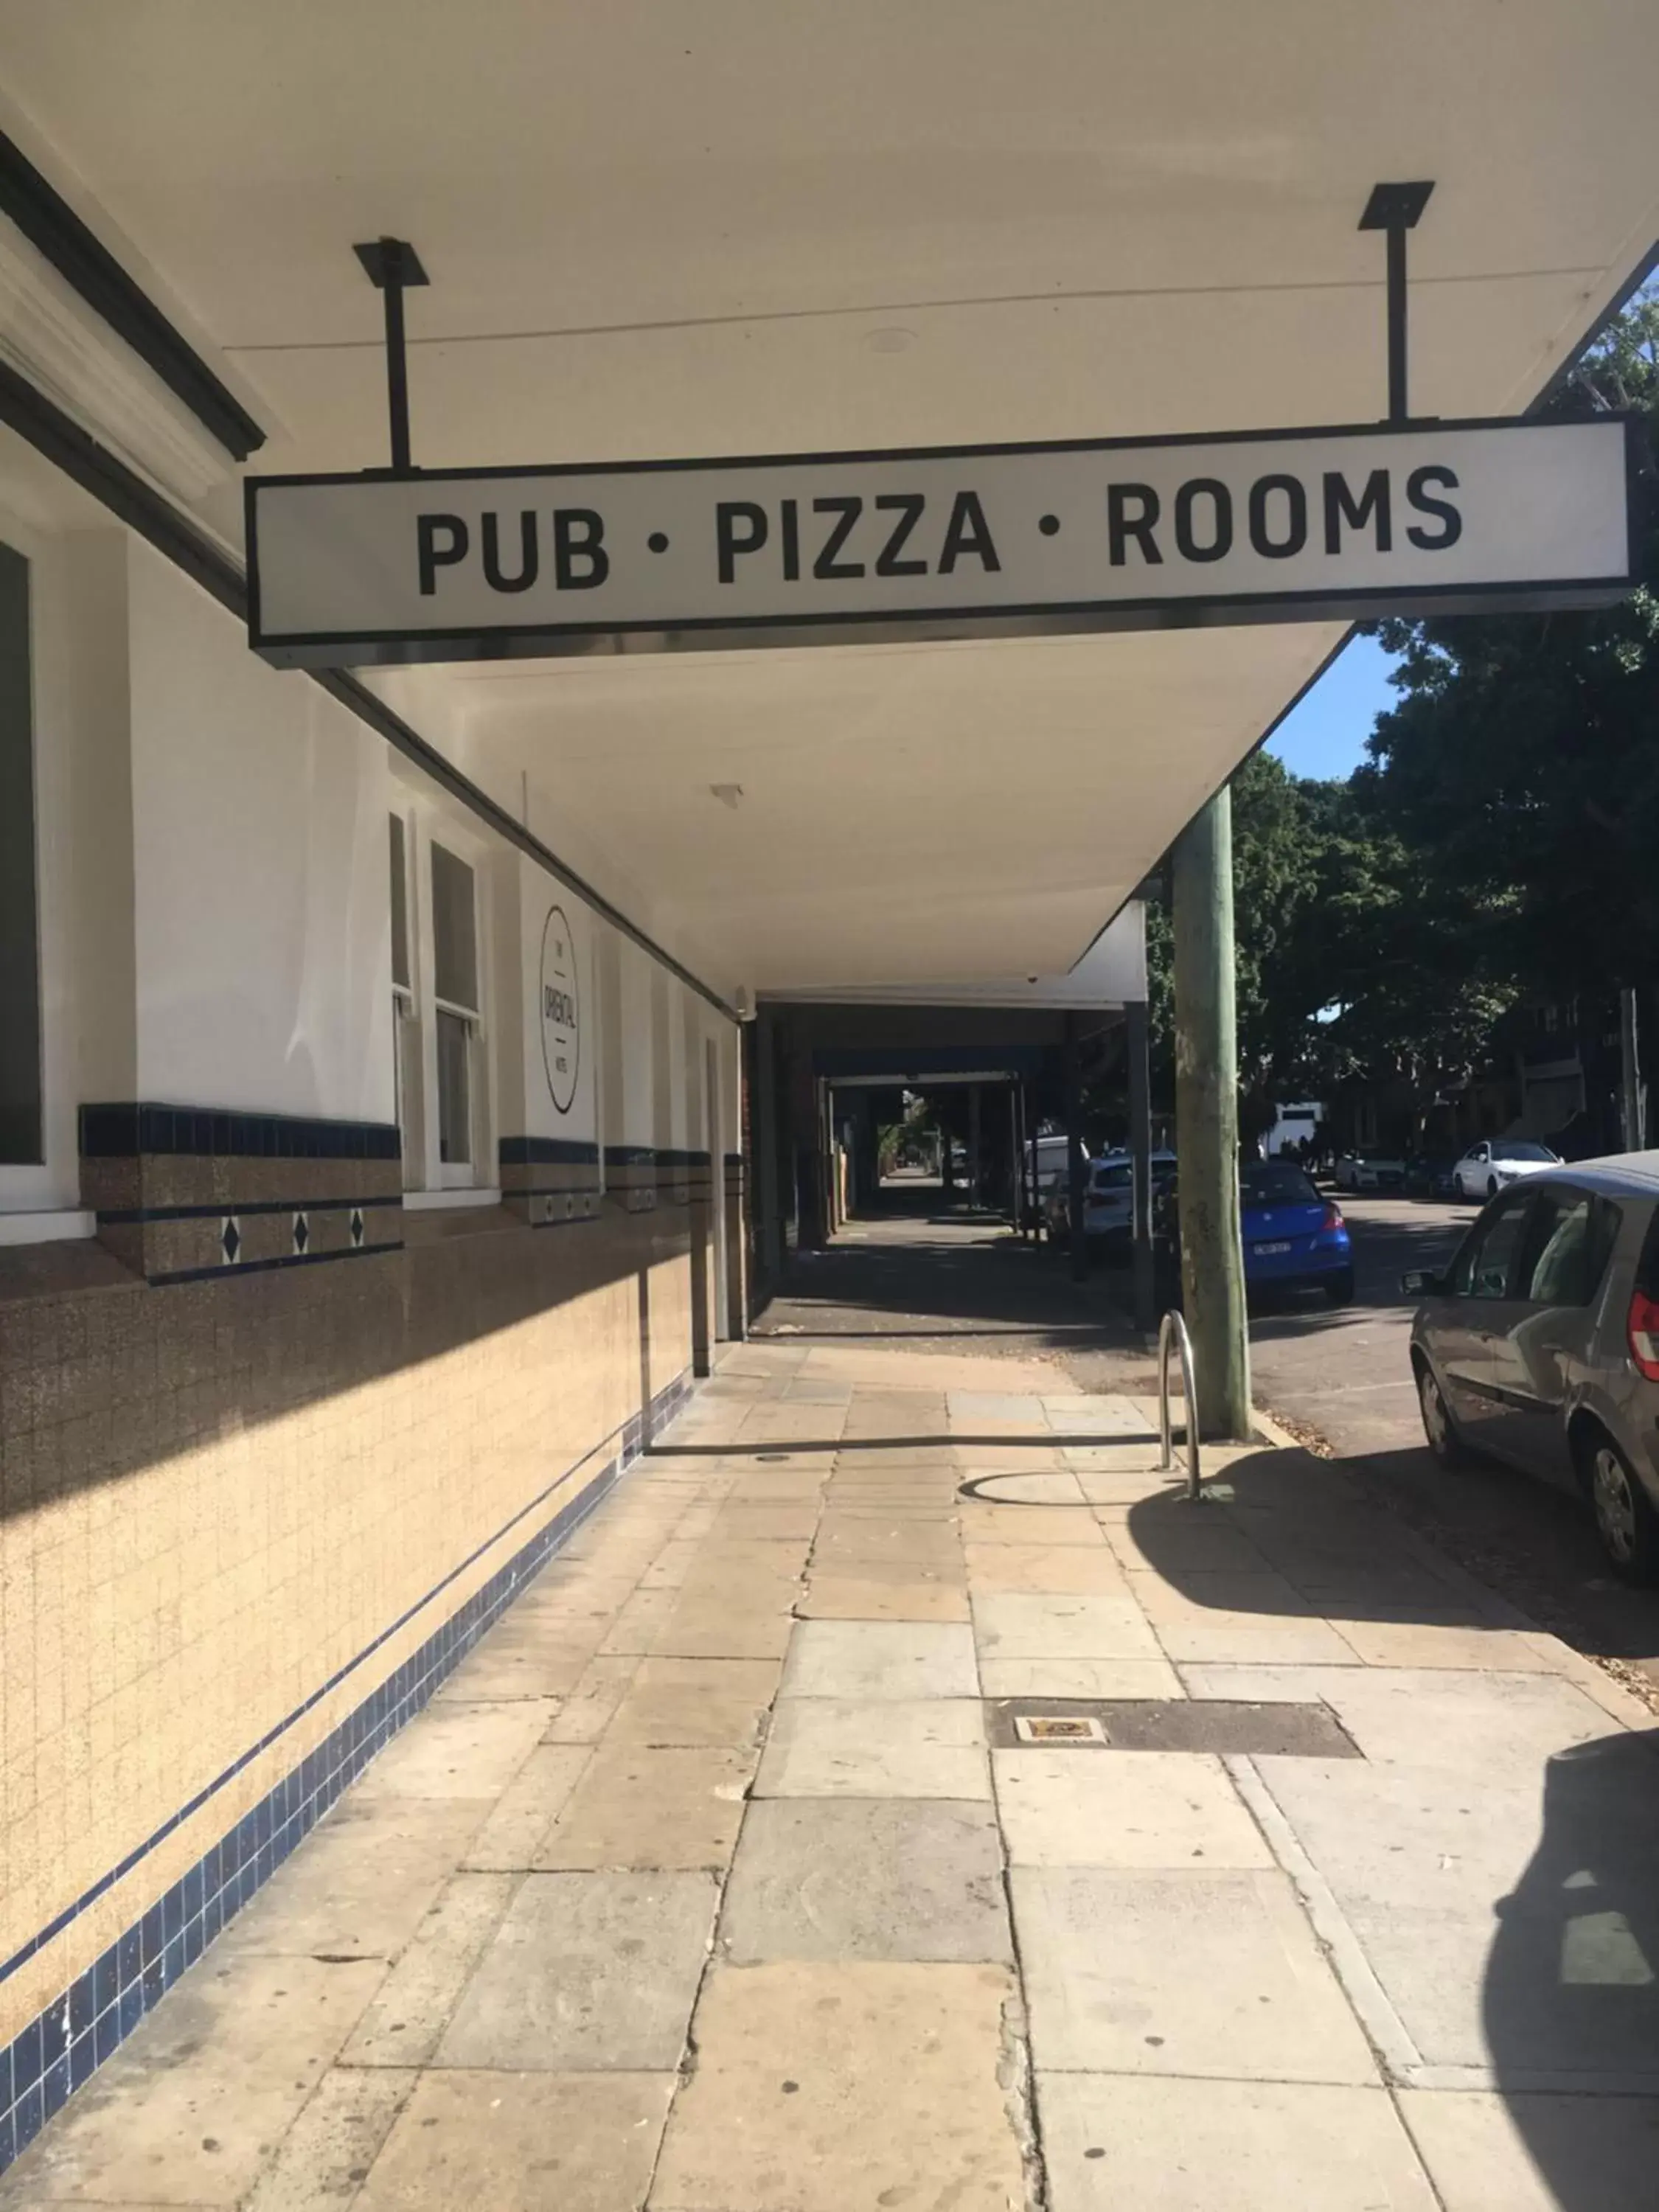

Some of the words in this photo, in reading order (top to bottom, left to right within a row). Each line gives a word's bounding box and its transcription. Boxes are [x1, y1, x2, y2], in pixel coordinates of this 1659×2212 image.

[416, 508, 610, 596] PUB
[716, 490, 1001, 585] PIZZA
[1107, 465, 1462, 566] ROOMS
